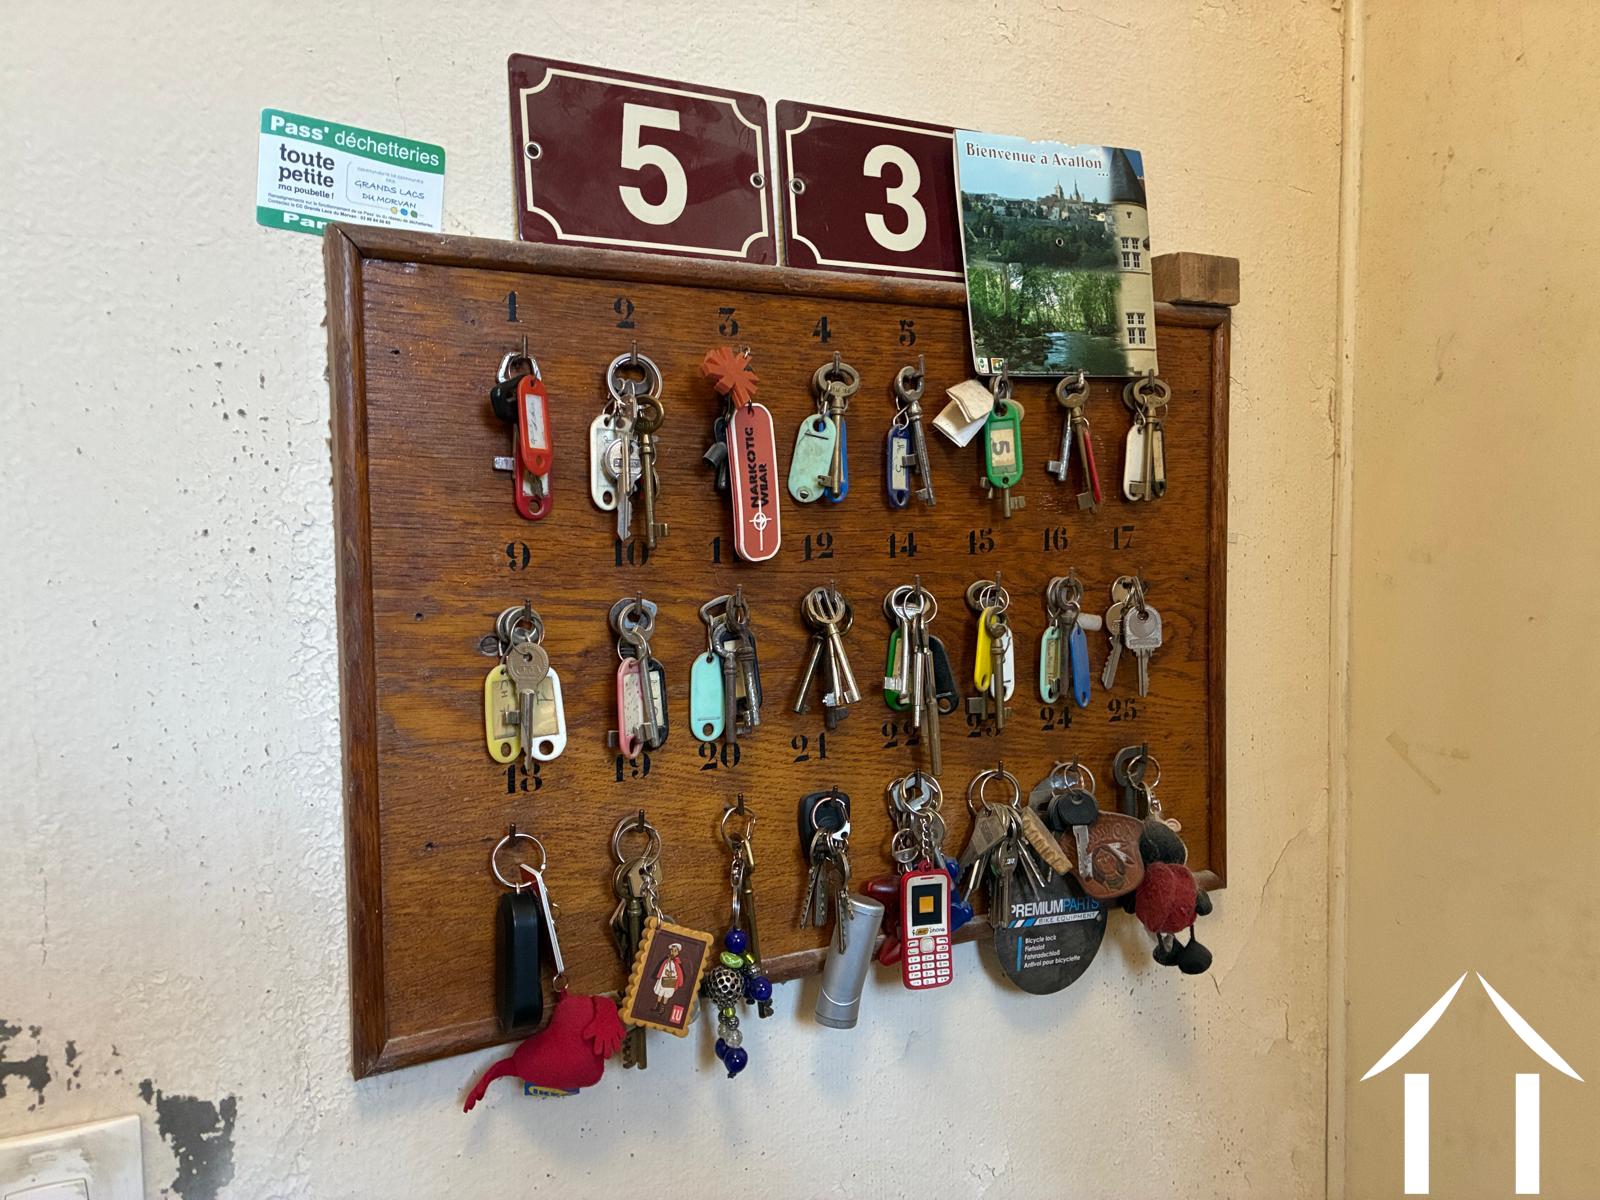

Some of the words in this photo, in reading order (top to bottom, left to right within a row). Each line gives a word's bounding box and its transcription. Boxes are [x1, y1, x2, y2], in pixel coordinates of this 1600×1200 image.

[270, 115, 329, 141] Pass'
[334, 131, 440, 166] déchetteries
[279, 143, 335, 171] toute
[618, 102, 688, 225] 5
[966, 142, 1037, 164] Bienvenue
[1052, 153, 1102, 169] Avallon
[278, 164, 335, 188] petite
[278, 183, 293, 192] ma
[354, 180, 397, 194] GRANDS
[399, 188, 425, 200] LACS
[362, 193, 374, 201] DU
[376, 195, 417, 209] MORVAN
[863, 144, 927, 252] 3
[504, 290, 522, 323] 1
[614, 295, 636, 329] 2
[716, 307, 739, 337] 3
[812, 316, 832, 343] 4
[899, 319, 916, 347] 5
[744, 427, 759, 509] NARKOTIC
[801, 532, 834, 561] 12
[886, 532, 918, 558] 14
[967, 528, 995, 555] 15
[1041, 526, 1069, 552] 16
[1109, 525, 1136, 550] 17
[505, 541, 531, 571] 9
[614, 538, 650, 568] 10
[1040, 705, 1073, 731] 24
[1107, 698, 1137, 722] 25
[791, 733, 827, 763] 21
[882, 719, 921, 749] 22
[615, 752, 651, 782] 19
[698, 741, 741, 771] 20
[504, 763, 543, 794] 18
[1056, 912, 1096, 922] EQUIPMENT
